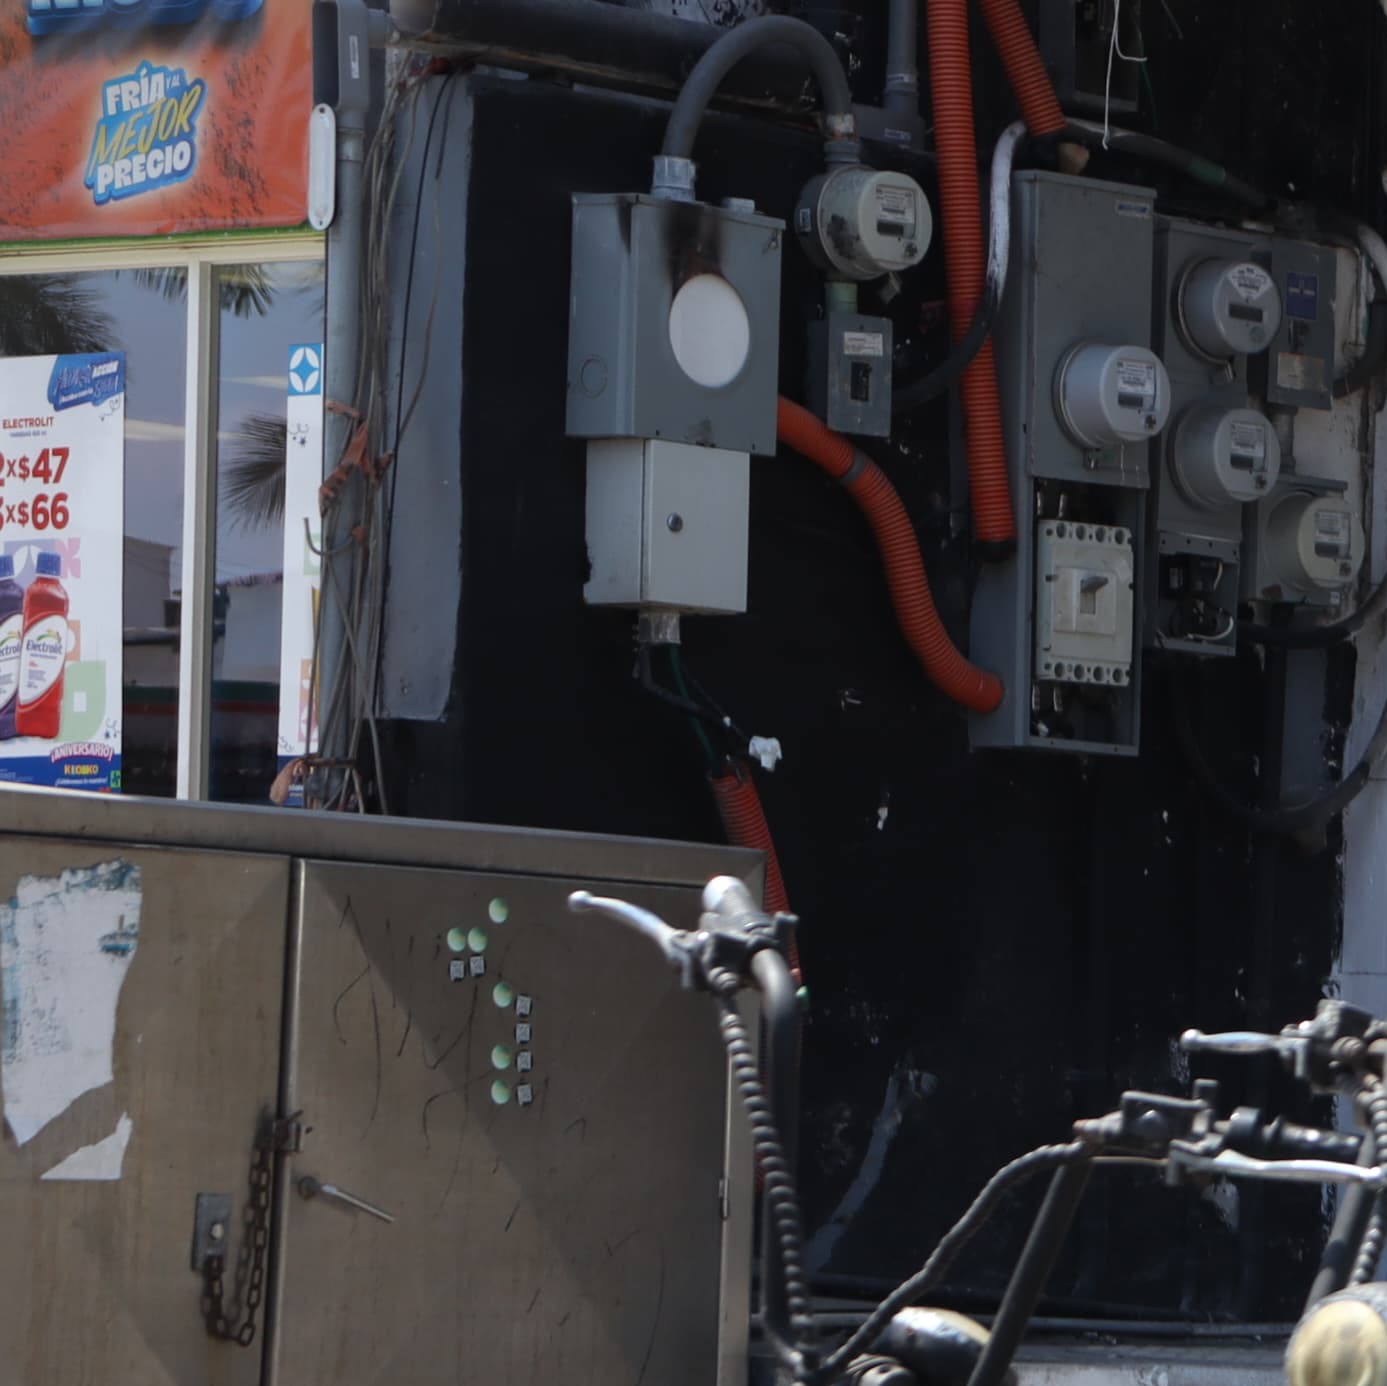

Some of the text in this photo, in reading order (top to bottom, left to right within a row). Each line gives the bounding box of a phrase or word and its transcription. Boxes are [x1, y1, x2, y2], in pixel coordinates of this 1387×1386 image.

[105, 67, 166, 116] FRÍA
[89, 84, 201, 176] MEJOR
[96, 140, 192, 194] PRECIO
[2, 417, 54, 429] ELECTROLIT
